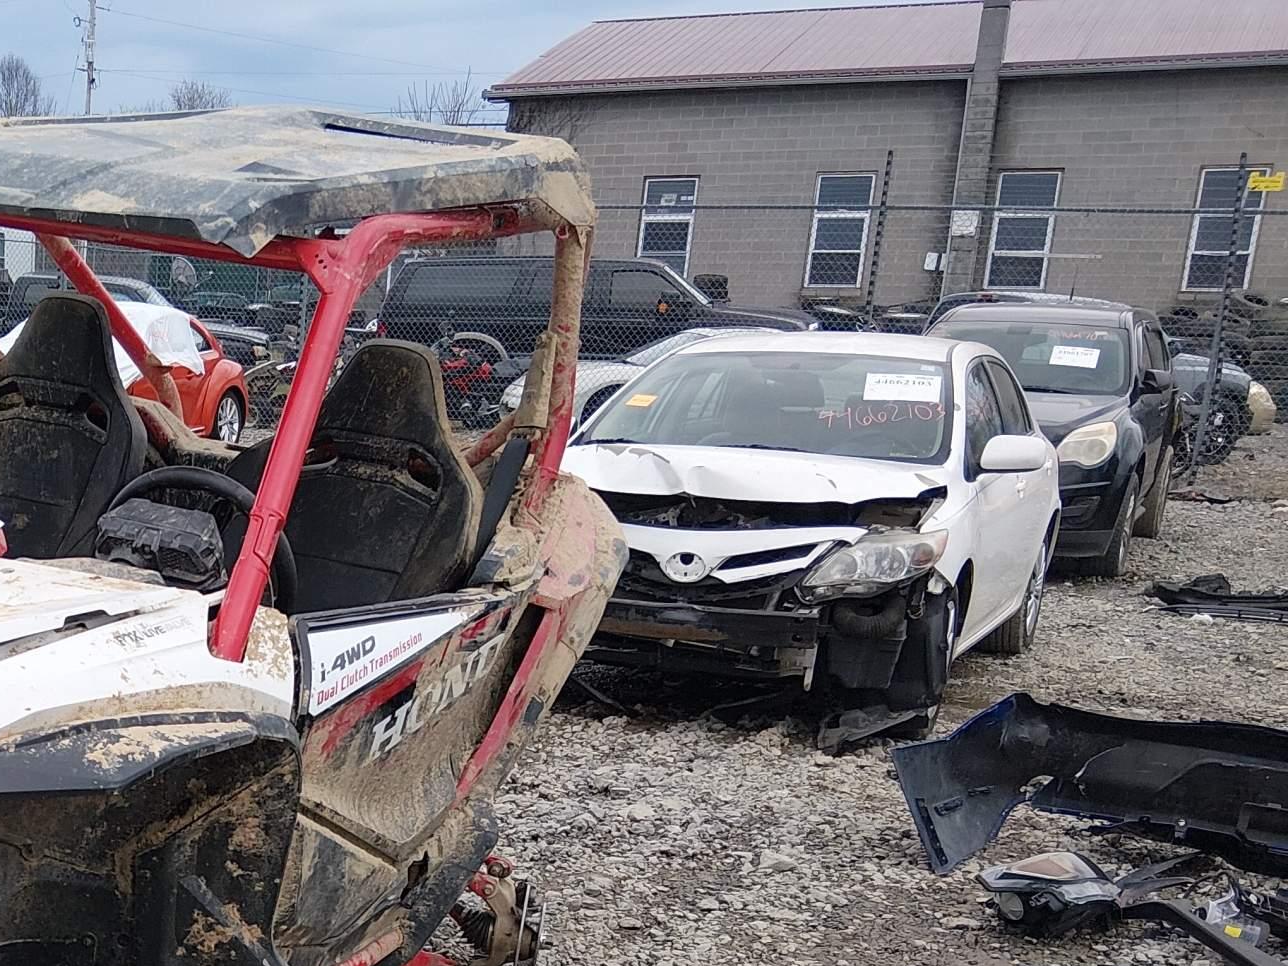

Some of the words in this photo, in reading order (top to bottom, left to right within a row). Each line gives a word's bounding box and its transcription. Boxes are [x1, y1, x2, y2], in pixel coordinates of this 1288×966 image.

[317, 680, 338, 706] Dual
[341, 663, 368, 691] Clutch
[369, 632, 423, 673] Transmission
[320, 635, 376, 683] i-4WD
